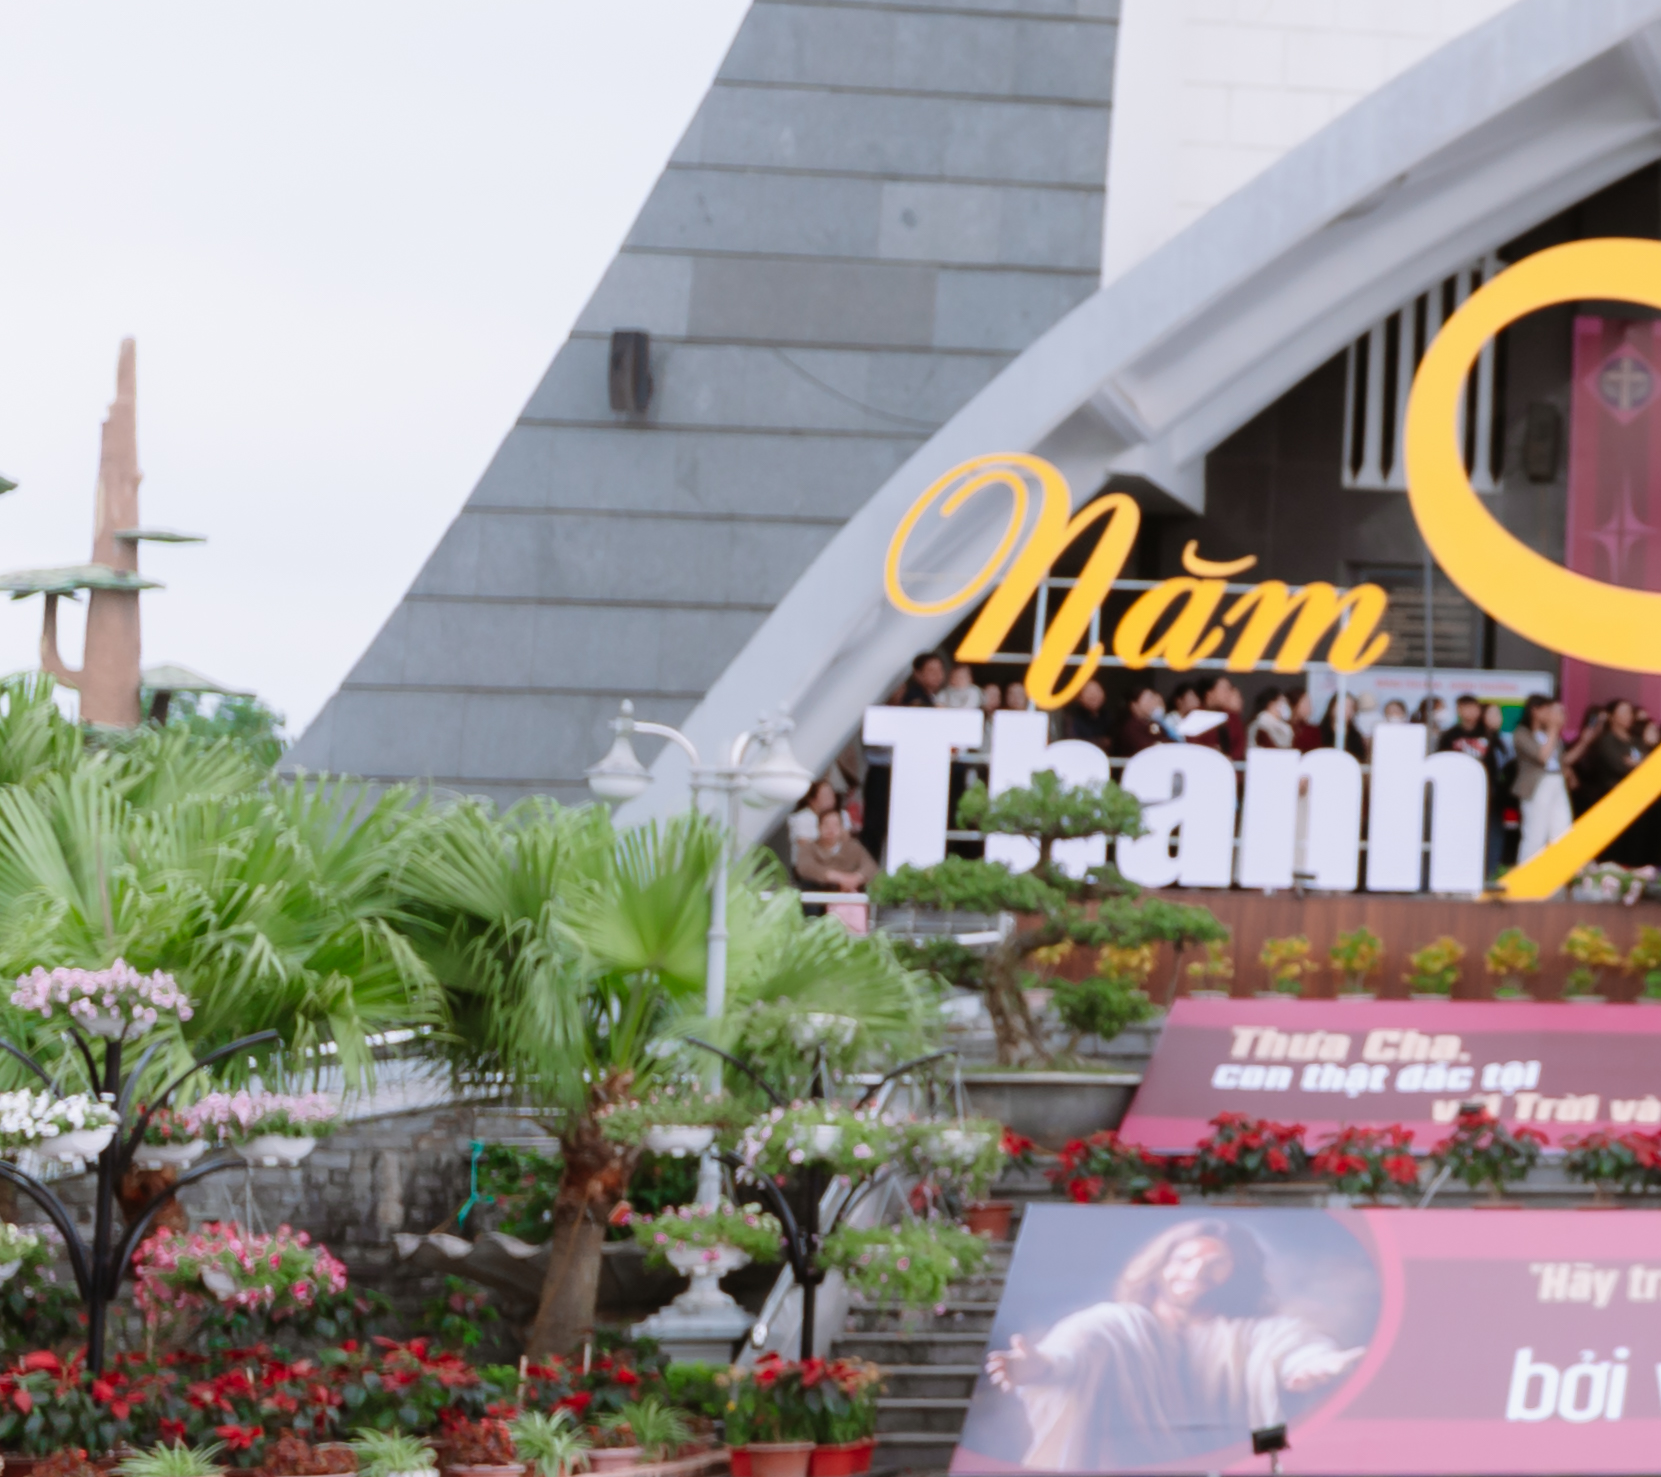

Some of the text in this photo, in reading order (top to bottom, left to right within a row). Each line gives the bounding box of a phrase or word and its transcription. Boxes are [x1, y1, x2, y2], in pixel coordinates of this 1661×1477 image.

[884, 452, 1393, 710] Năm
[1230, 1025, 1351, 1062] Thưa
[1212, 1063, 1294, 1091] con
[1505, 1345, 1632, 1423] bởi
